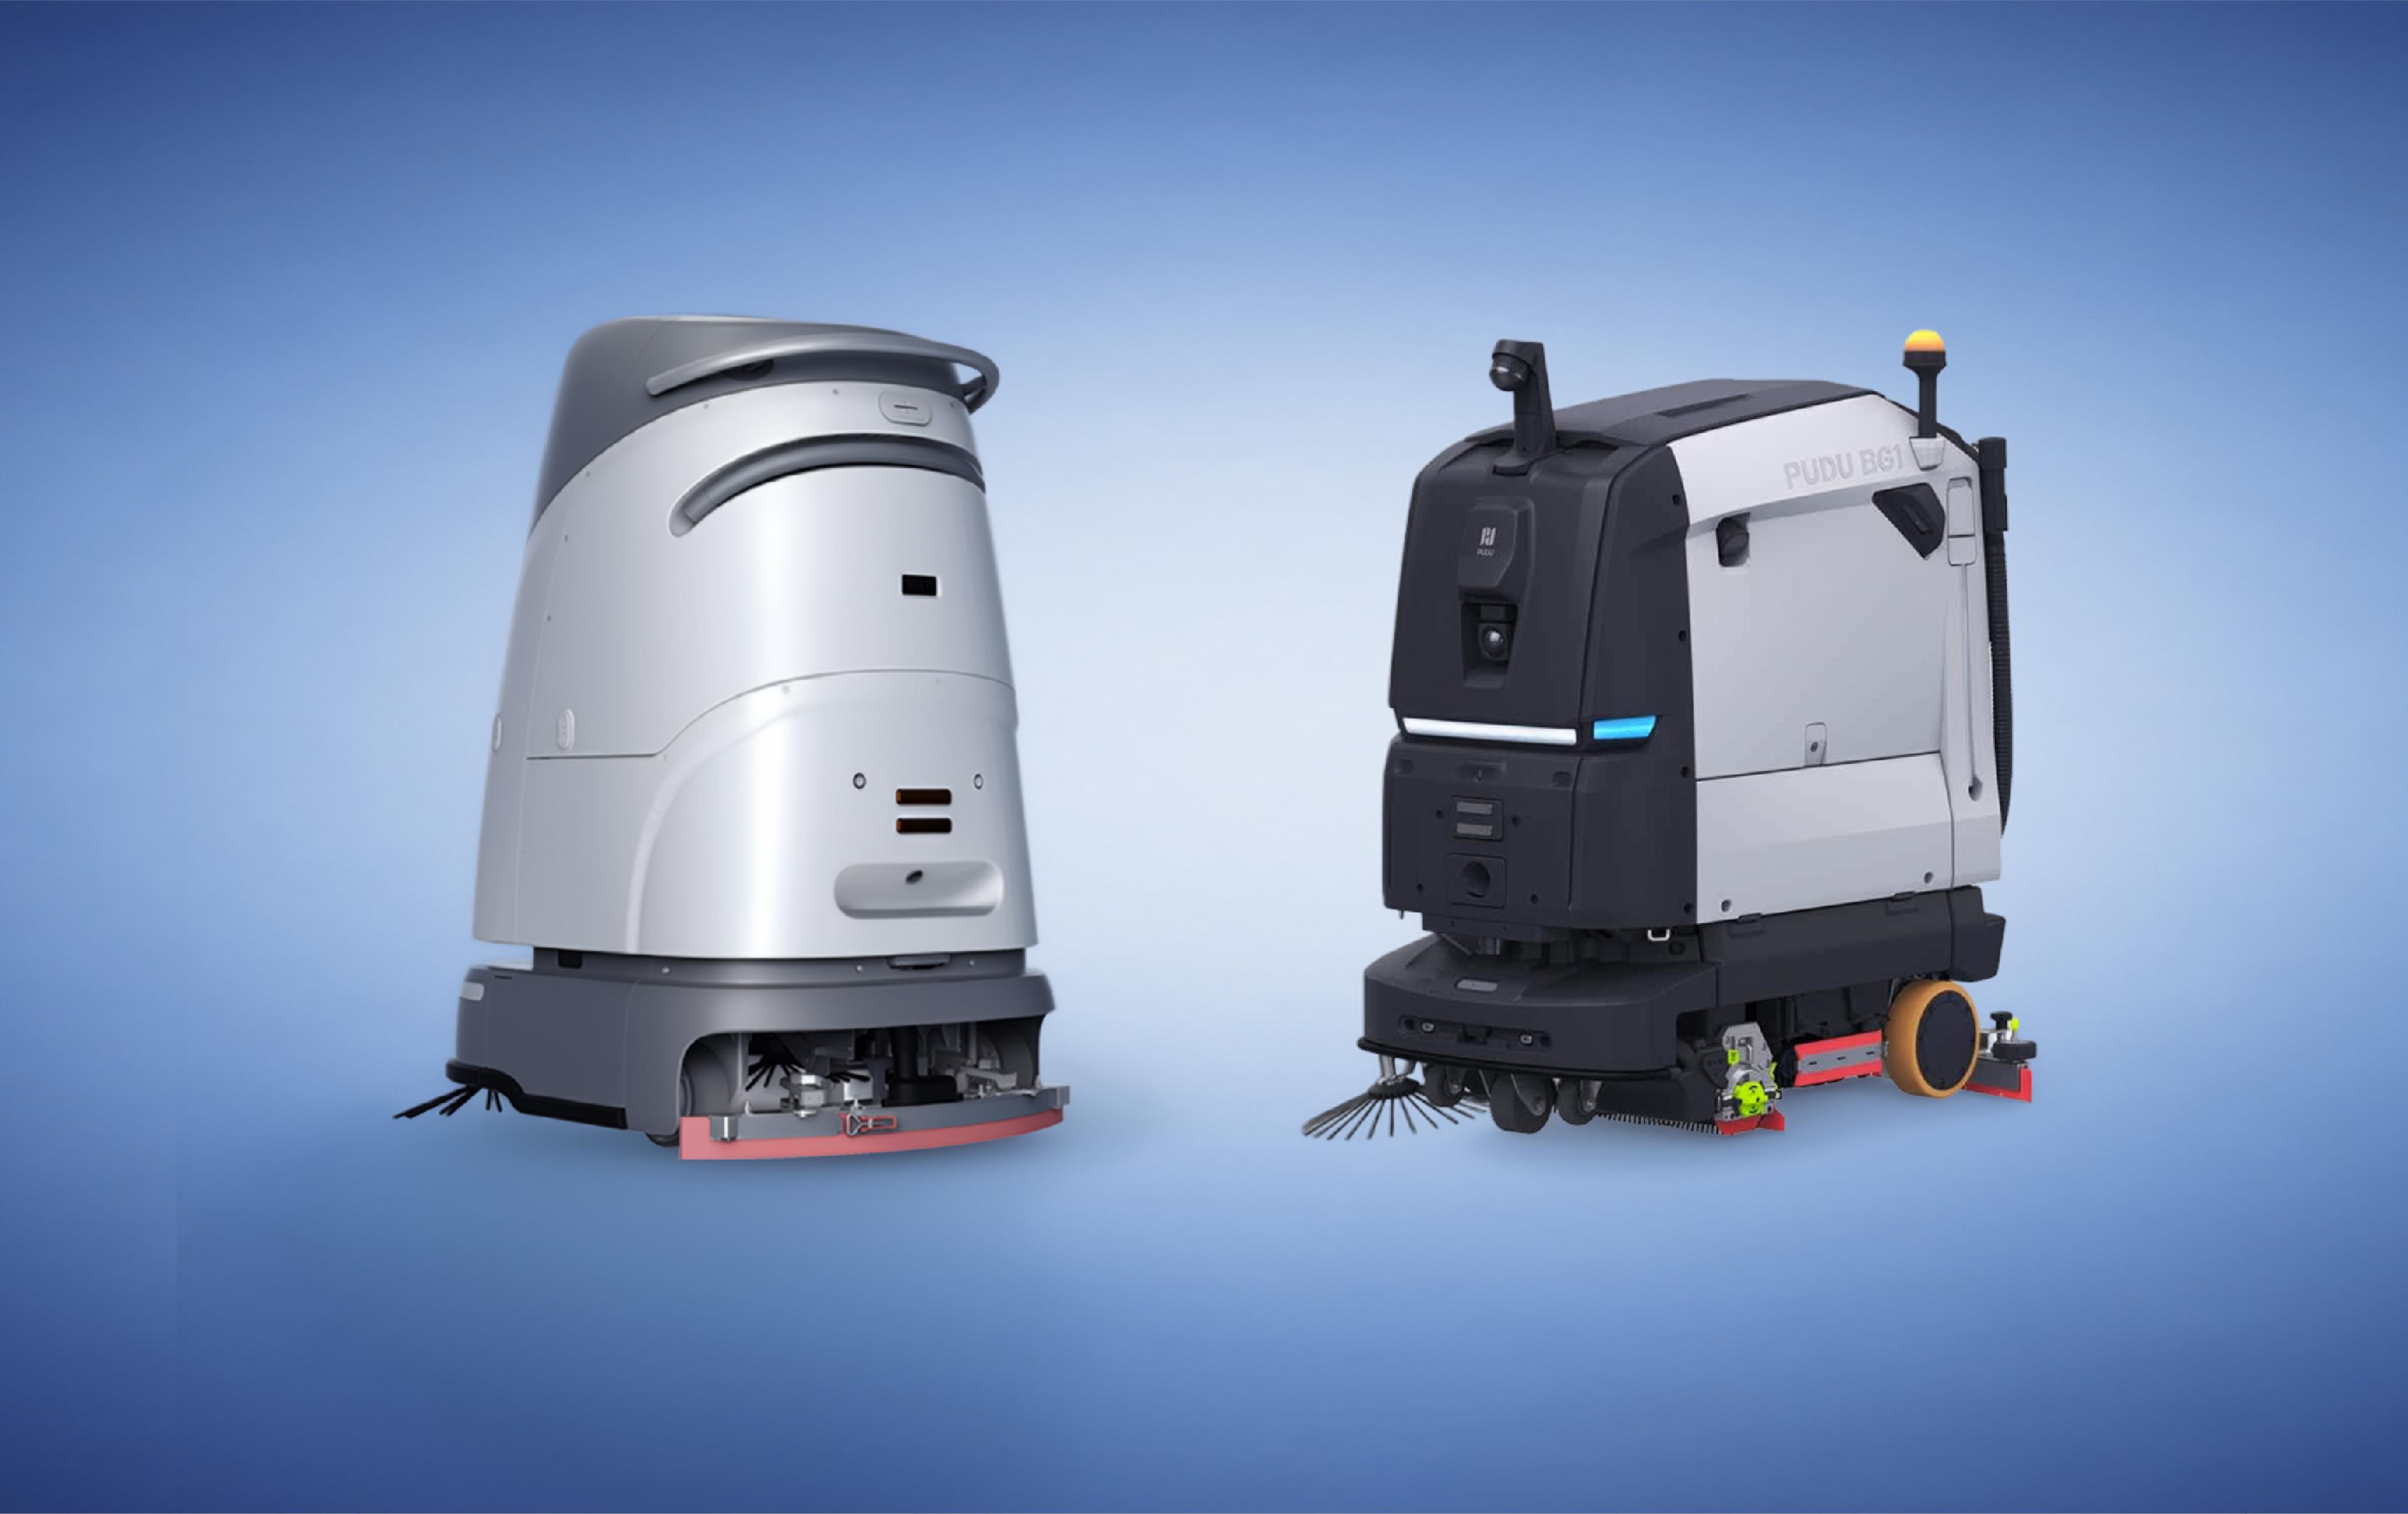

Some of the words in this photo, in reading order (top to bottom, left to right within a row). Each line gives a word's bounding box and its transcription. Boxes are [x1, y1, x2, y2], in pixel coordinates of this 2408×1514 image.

[1783, 453, 1853, 489] PUDU
[1859, 444, 1903, 475] BG1
[1477, 549, 1495, 557] PUDU
